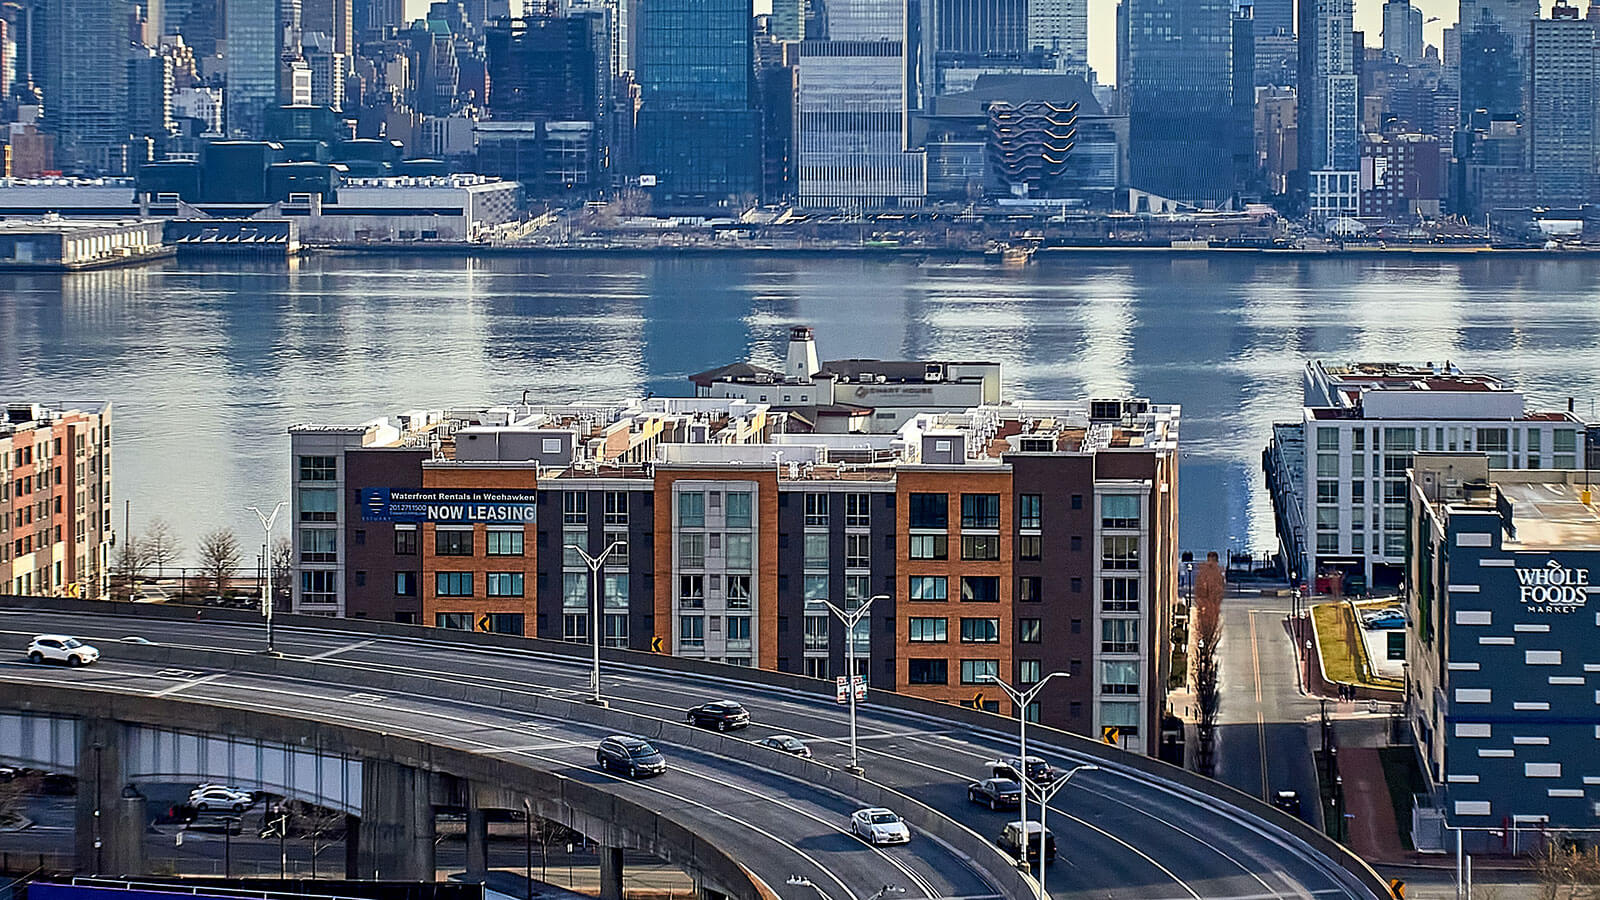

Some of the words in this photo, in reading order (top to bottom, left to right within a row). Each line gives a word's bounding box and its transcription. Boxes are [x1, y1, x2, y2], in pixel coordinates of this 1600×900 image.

[391, 492, 436, 500] Waterfront
[439, 492, 471, 500] Rentals
[483, 492, 535, 501] Weehawken
[427, 505, 464, 520] NOW
[468, 506, 534, 521] LEASING
[1515, 567, 1589, 585] WHOLE
[1519, 586, 1587, 603] FOODS
